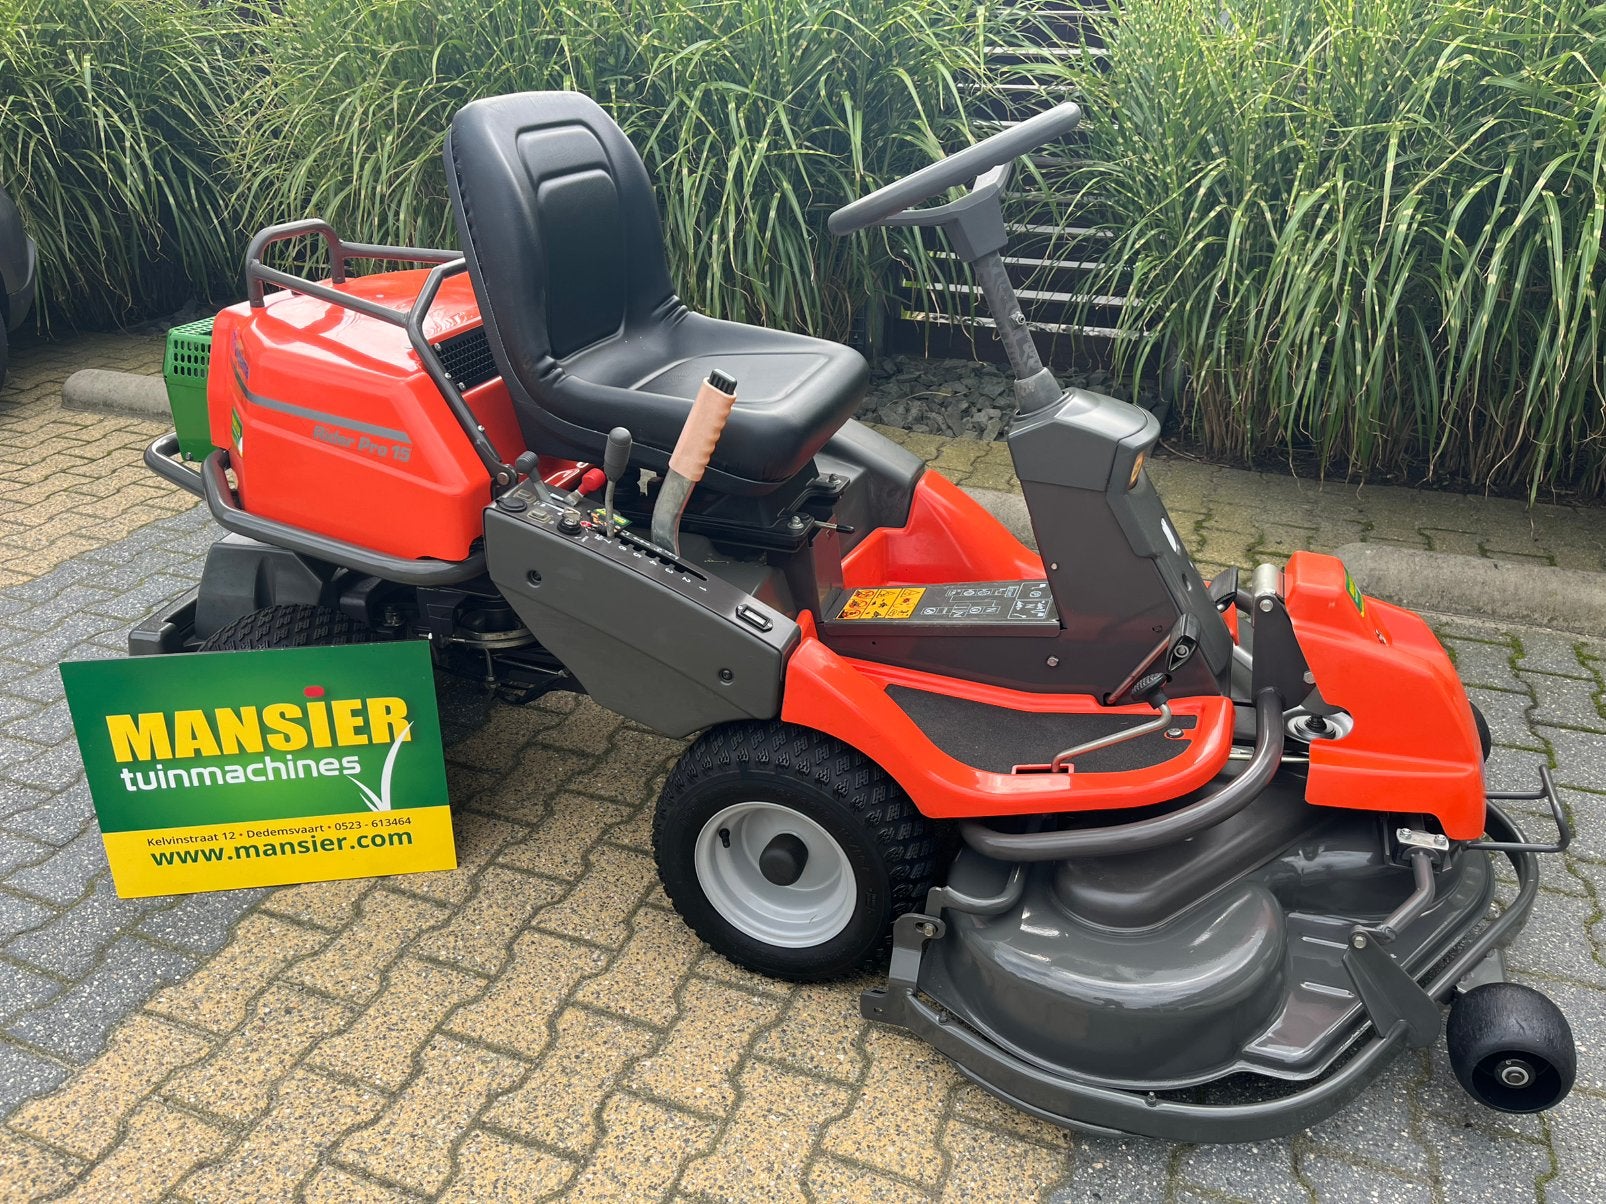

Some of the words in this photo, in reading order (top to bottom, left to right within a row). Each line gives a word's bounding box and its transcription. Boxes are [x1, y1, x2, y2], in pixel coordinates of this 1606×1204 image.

[314, 425, 355, 448] Rider
[358, 436, 387, 457] Pro
[392, 445, 411, 462] 15
[120, 756, 361, 792] tuinmachines
[147, 832, 219, 847] Kelvinstraat
[223, 831, 236, 841] 12
[247, 824, 324, 839] Dedemsvaart
[334, 821, 362, 831] 0523
[371, 817, 412, 828] 613464
[150, 831, 413, 866] www.mansier.com
